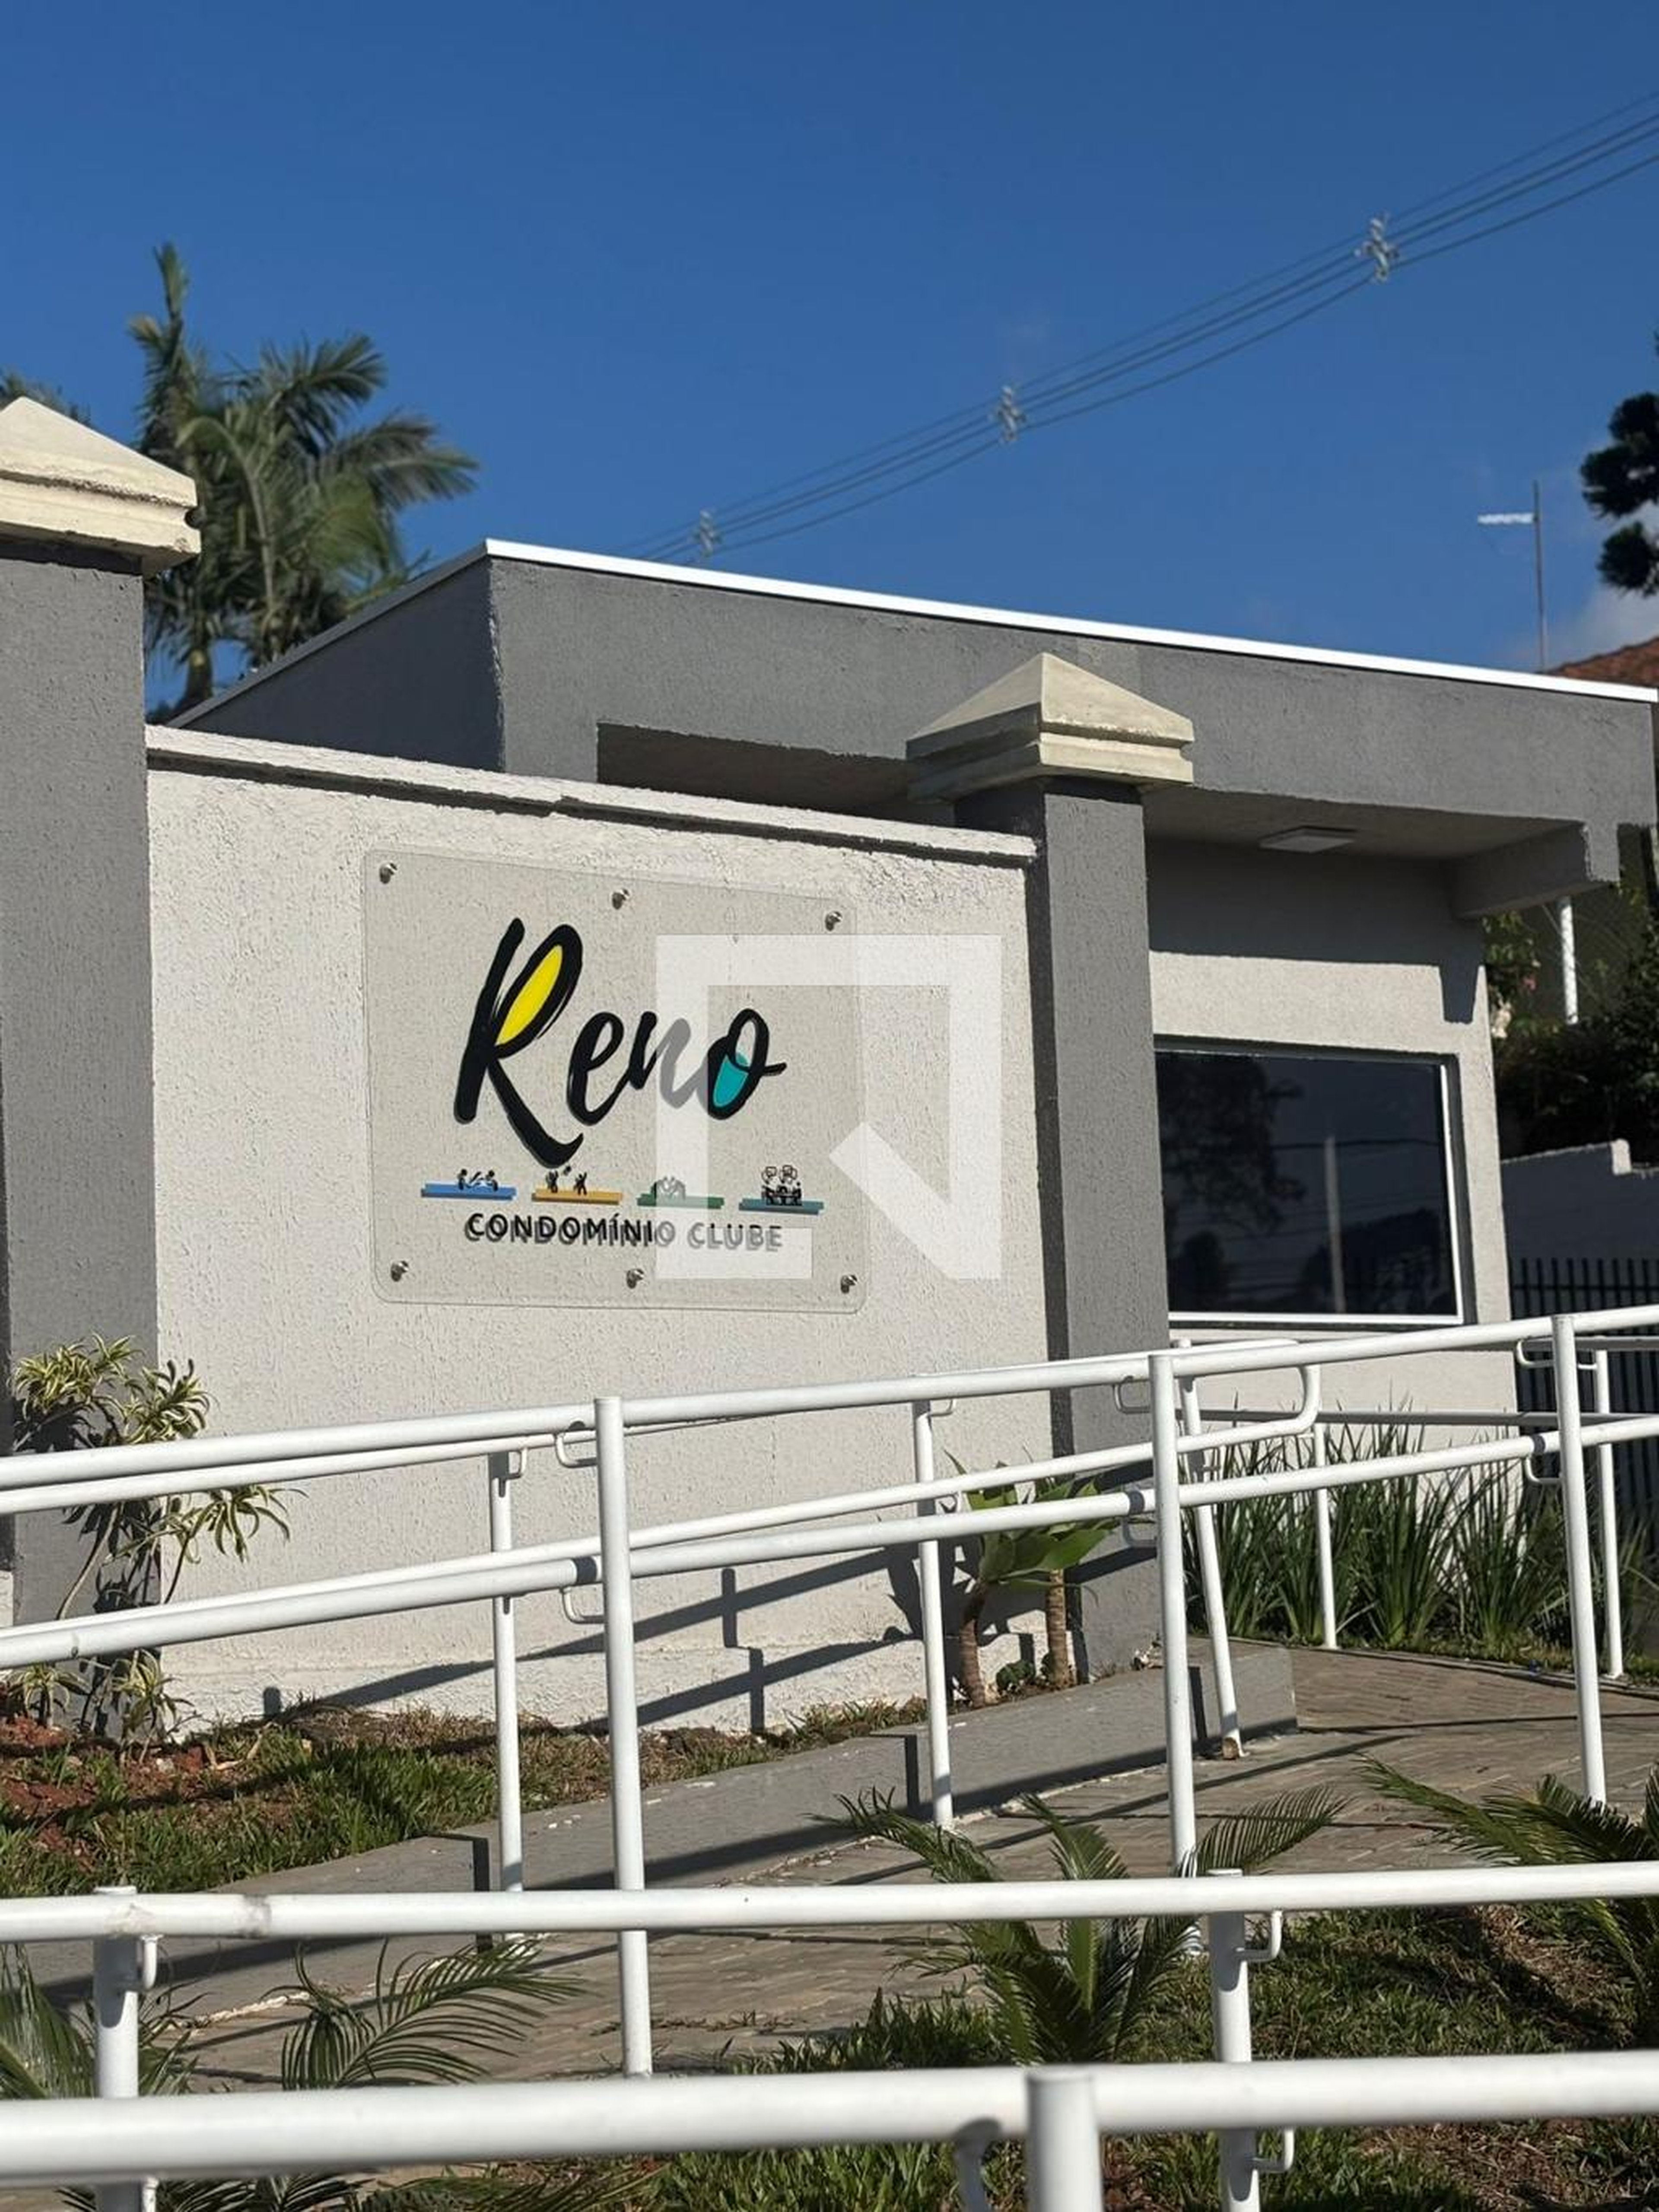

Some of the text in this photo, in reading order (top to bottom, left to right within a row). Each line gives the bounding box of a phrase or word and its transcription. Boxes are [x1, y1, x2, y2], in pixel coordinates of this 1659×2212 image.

[454, 918, 787, 1168] Reno
[467, 1213, 782, 1248] CONDOMÍNIO CLUBE
